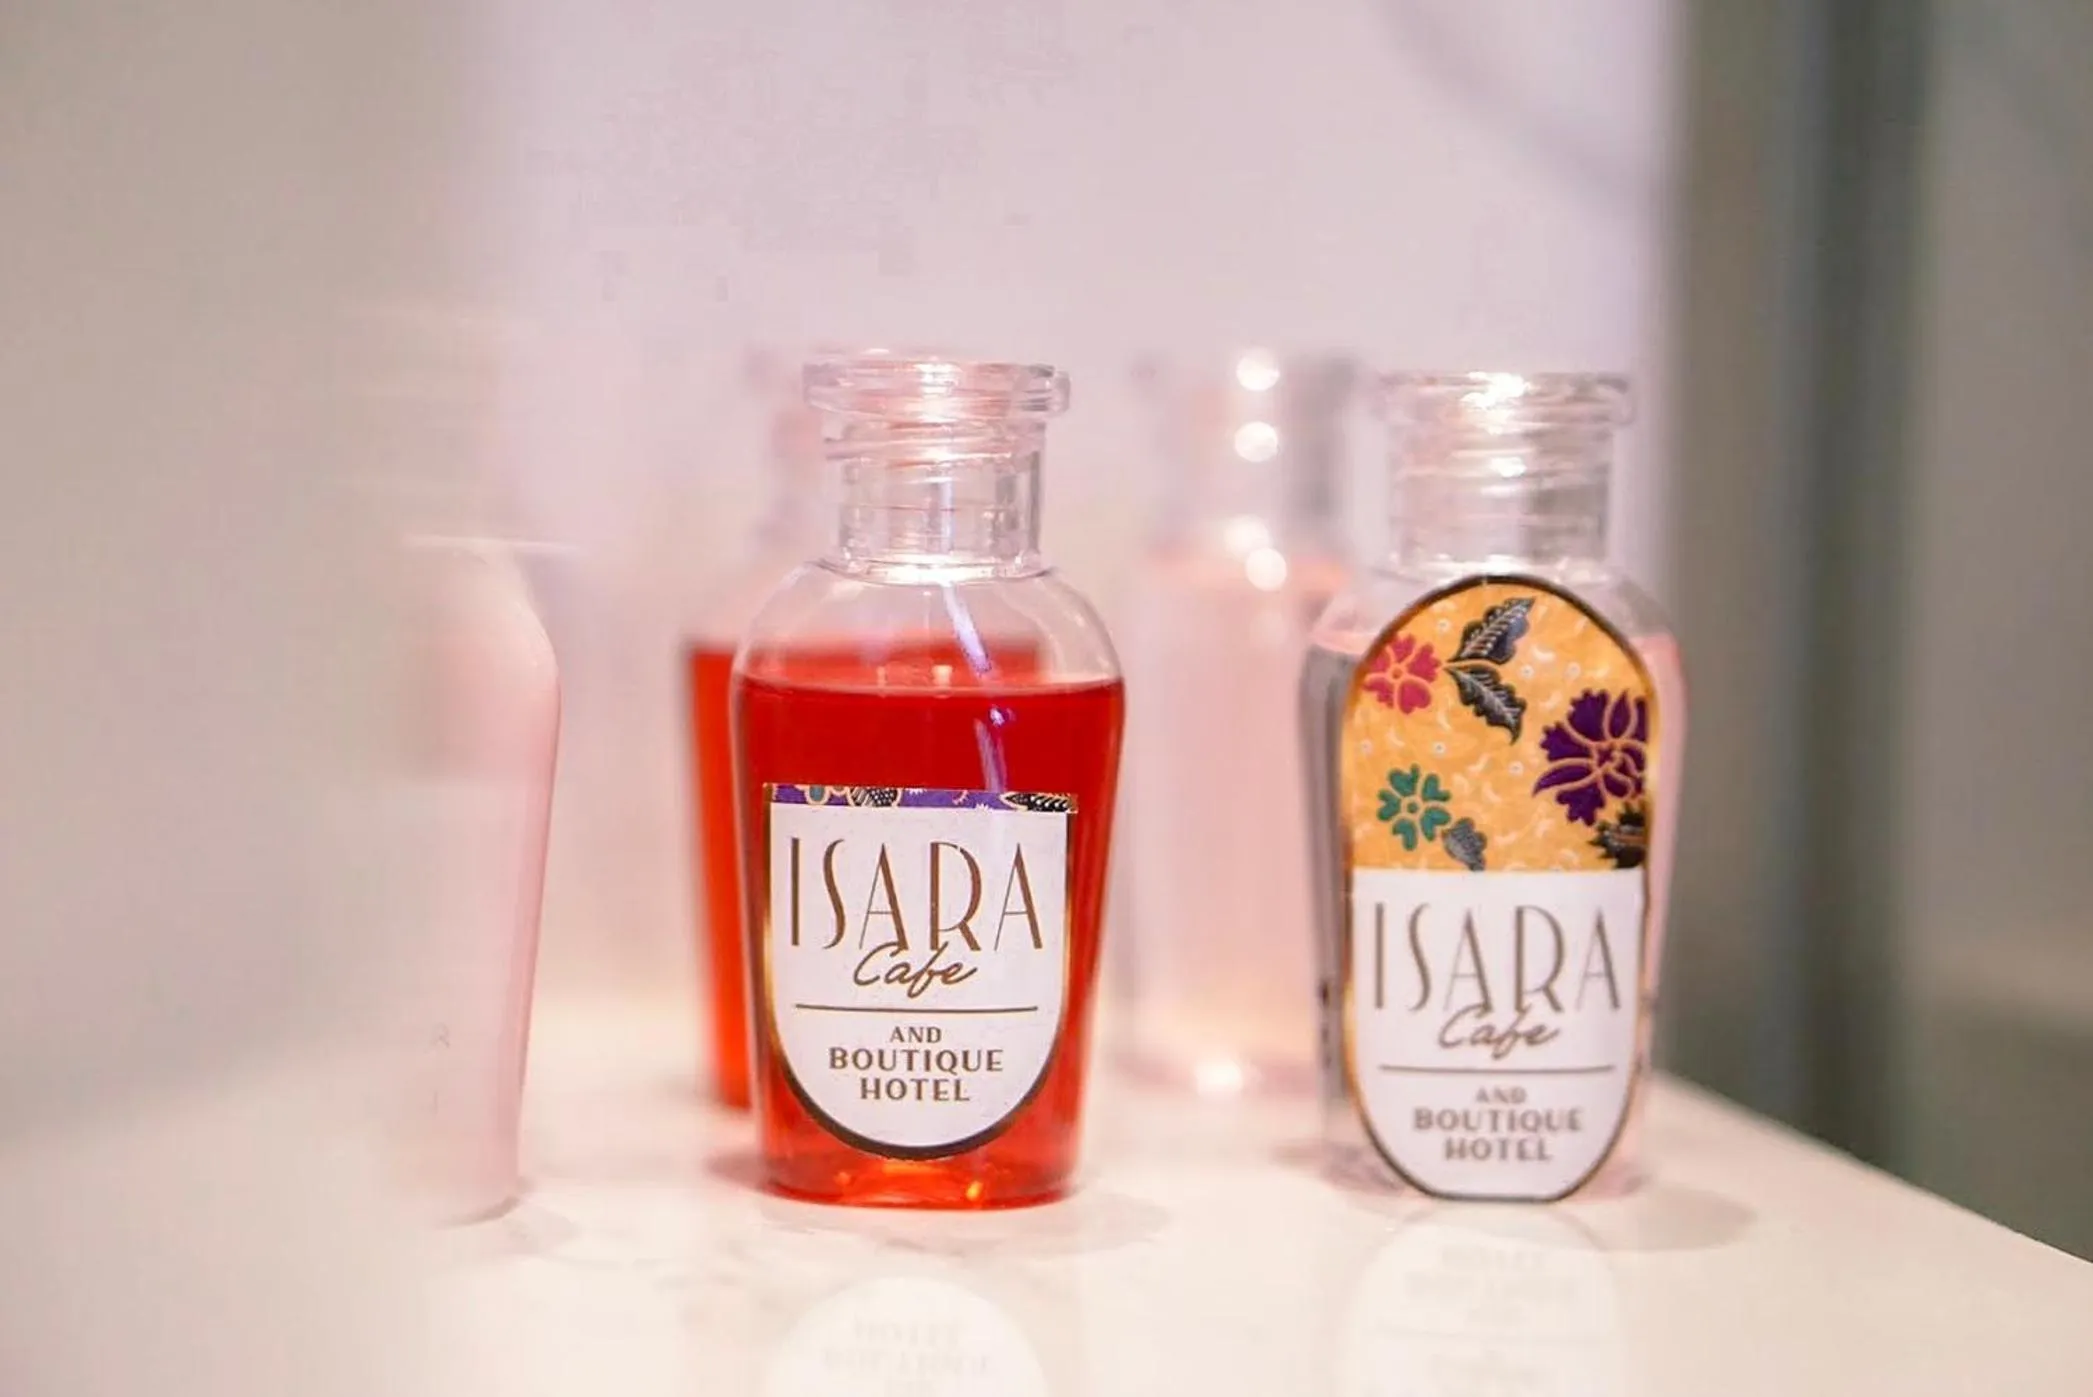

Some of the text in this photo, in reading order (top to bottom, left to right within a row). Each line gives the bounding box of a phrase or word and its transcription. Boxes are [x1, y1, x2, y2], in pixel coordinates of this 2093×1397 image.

[790, 837, 1043, 952] ISARA
[853, 940, 978, 999] Cafe
[1374, 902, 1621, 1013] ISARA
[890, 1026, 942, 1044] AND
[1438, 1003, 1561, 1060] Cafe
[829, 1047, 1004, 1073] BOUTIQUE
[860, 1078, 970, 1101] HOTEL
[1475, 1086, 1528, 1104] AND
[1414, 1108, 1582, 1132] BOUTIQUE
[1445, 1138, 1554, 1162] HOTEL
